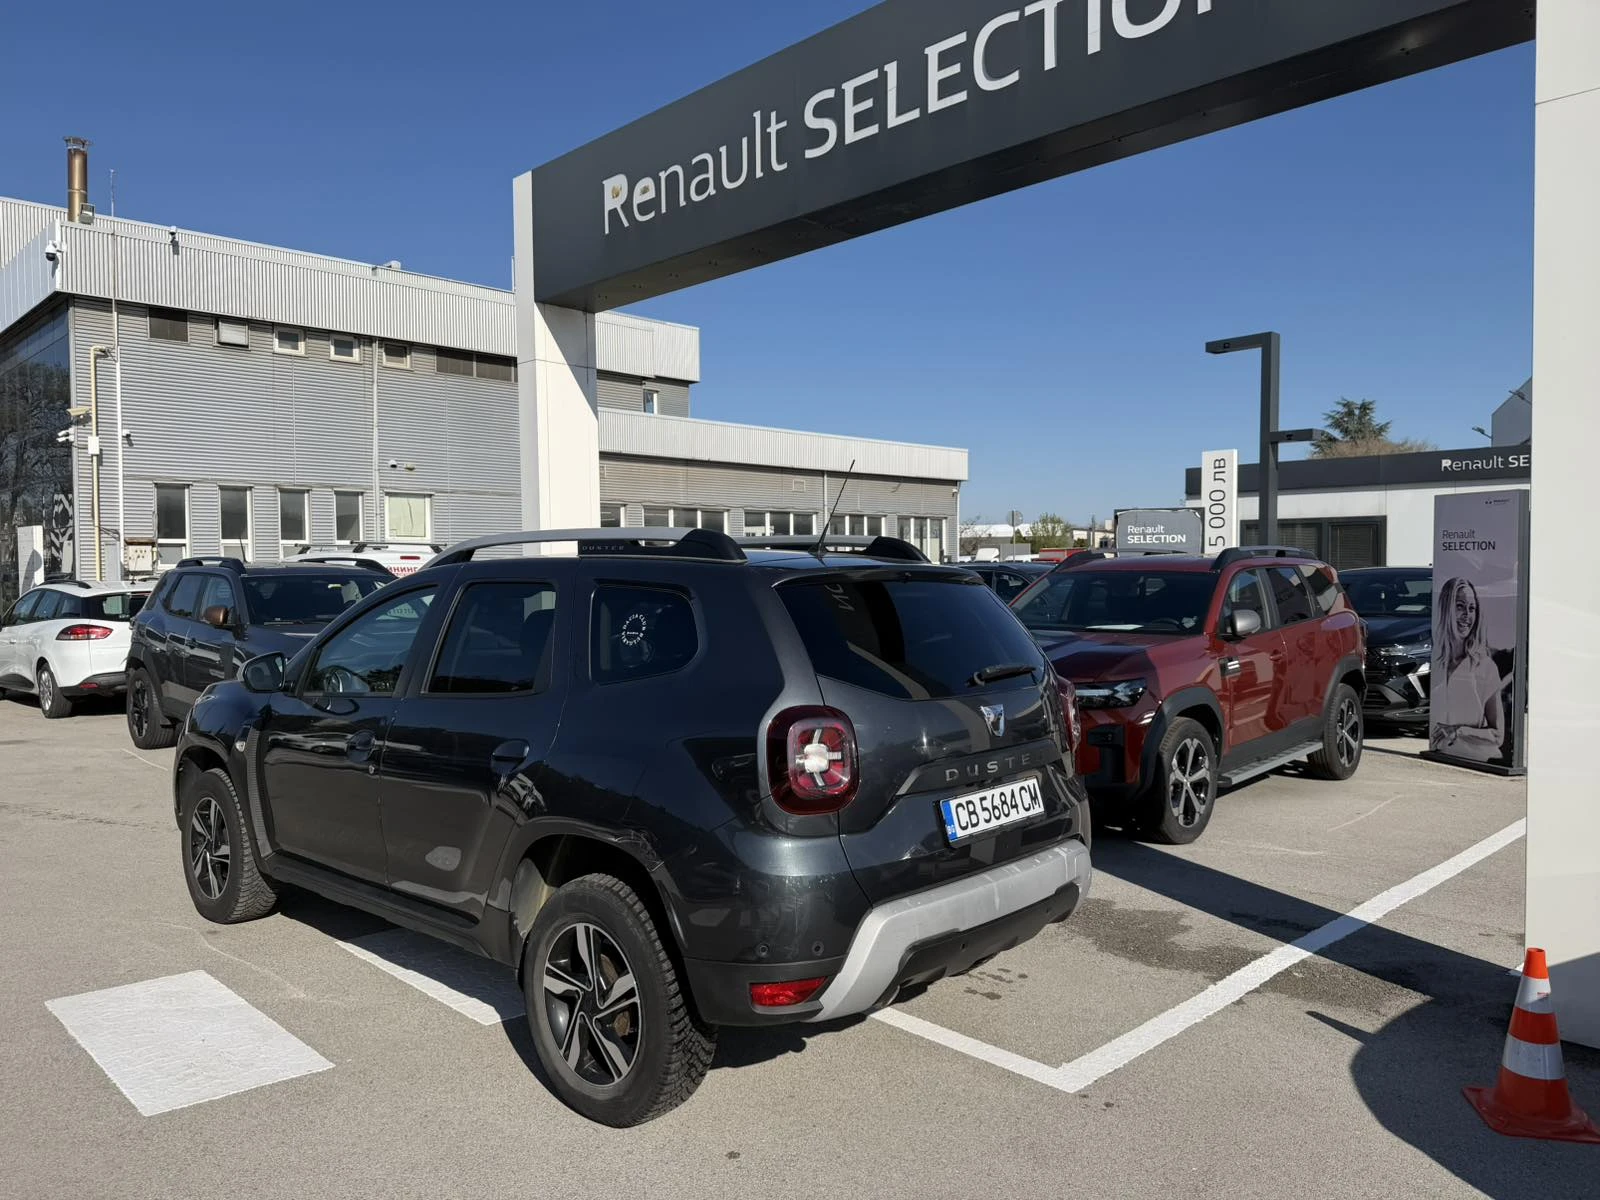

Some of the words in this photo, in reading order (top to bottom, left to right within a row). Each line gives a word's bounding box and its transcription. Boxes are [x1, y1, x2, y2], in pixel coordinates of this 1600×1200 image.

[602, 110, 788, 234] Renault
[803, 0, 1212, 159] SELECTI
[1441, 456, 1504, 471] Renault
[1127, 525, 1165, 534] Renault
[1442, 529, 1475, 539] Renault
[1127, 534, 1186, 544] SELECTION
[1442, 541, 1496, 551] SELECTION
[945, 753, 1032, 782] DUSTE
[979, 788, 1019, 824] 5684
